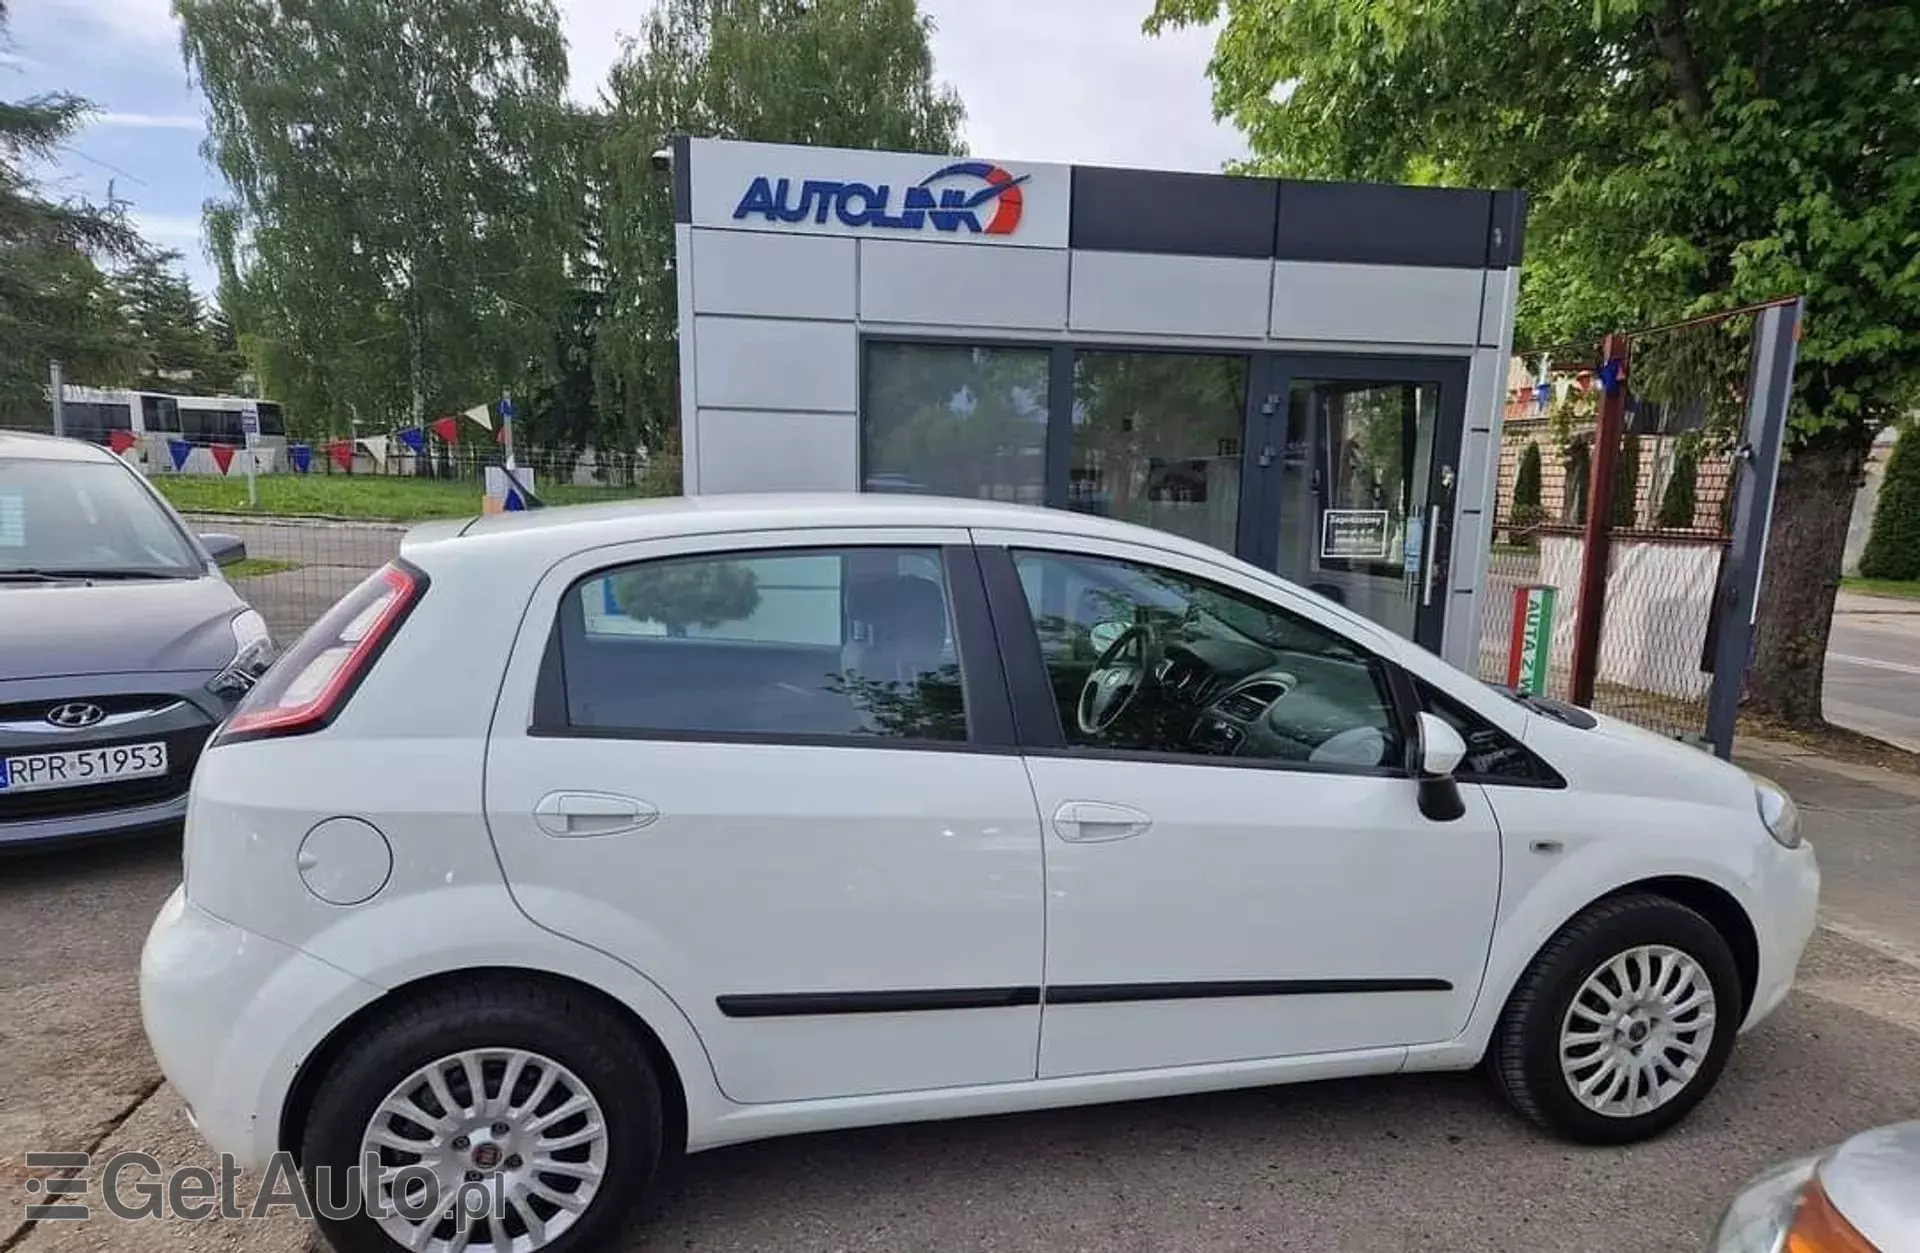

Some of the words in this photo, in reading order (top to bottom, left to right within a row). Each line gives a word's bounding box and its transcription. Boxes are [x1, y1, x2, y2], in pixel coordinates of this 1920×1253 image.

[733, 176, 985, 233] AUTOLINK
[1523, 600, 1540, 651] AUTA
[1521, 659, 1534, 671] Z
[8, 755, 67, 784] RPR
[78, 745, 164, 776] 51953
